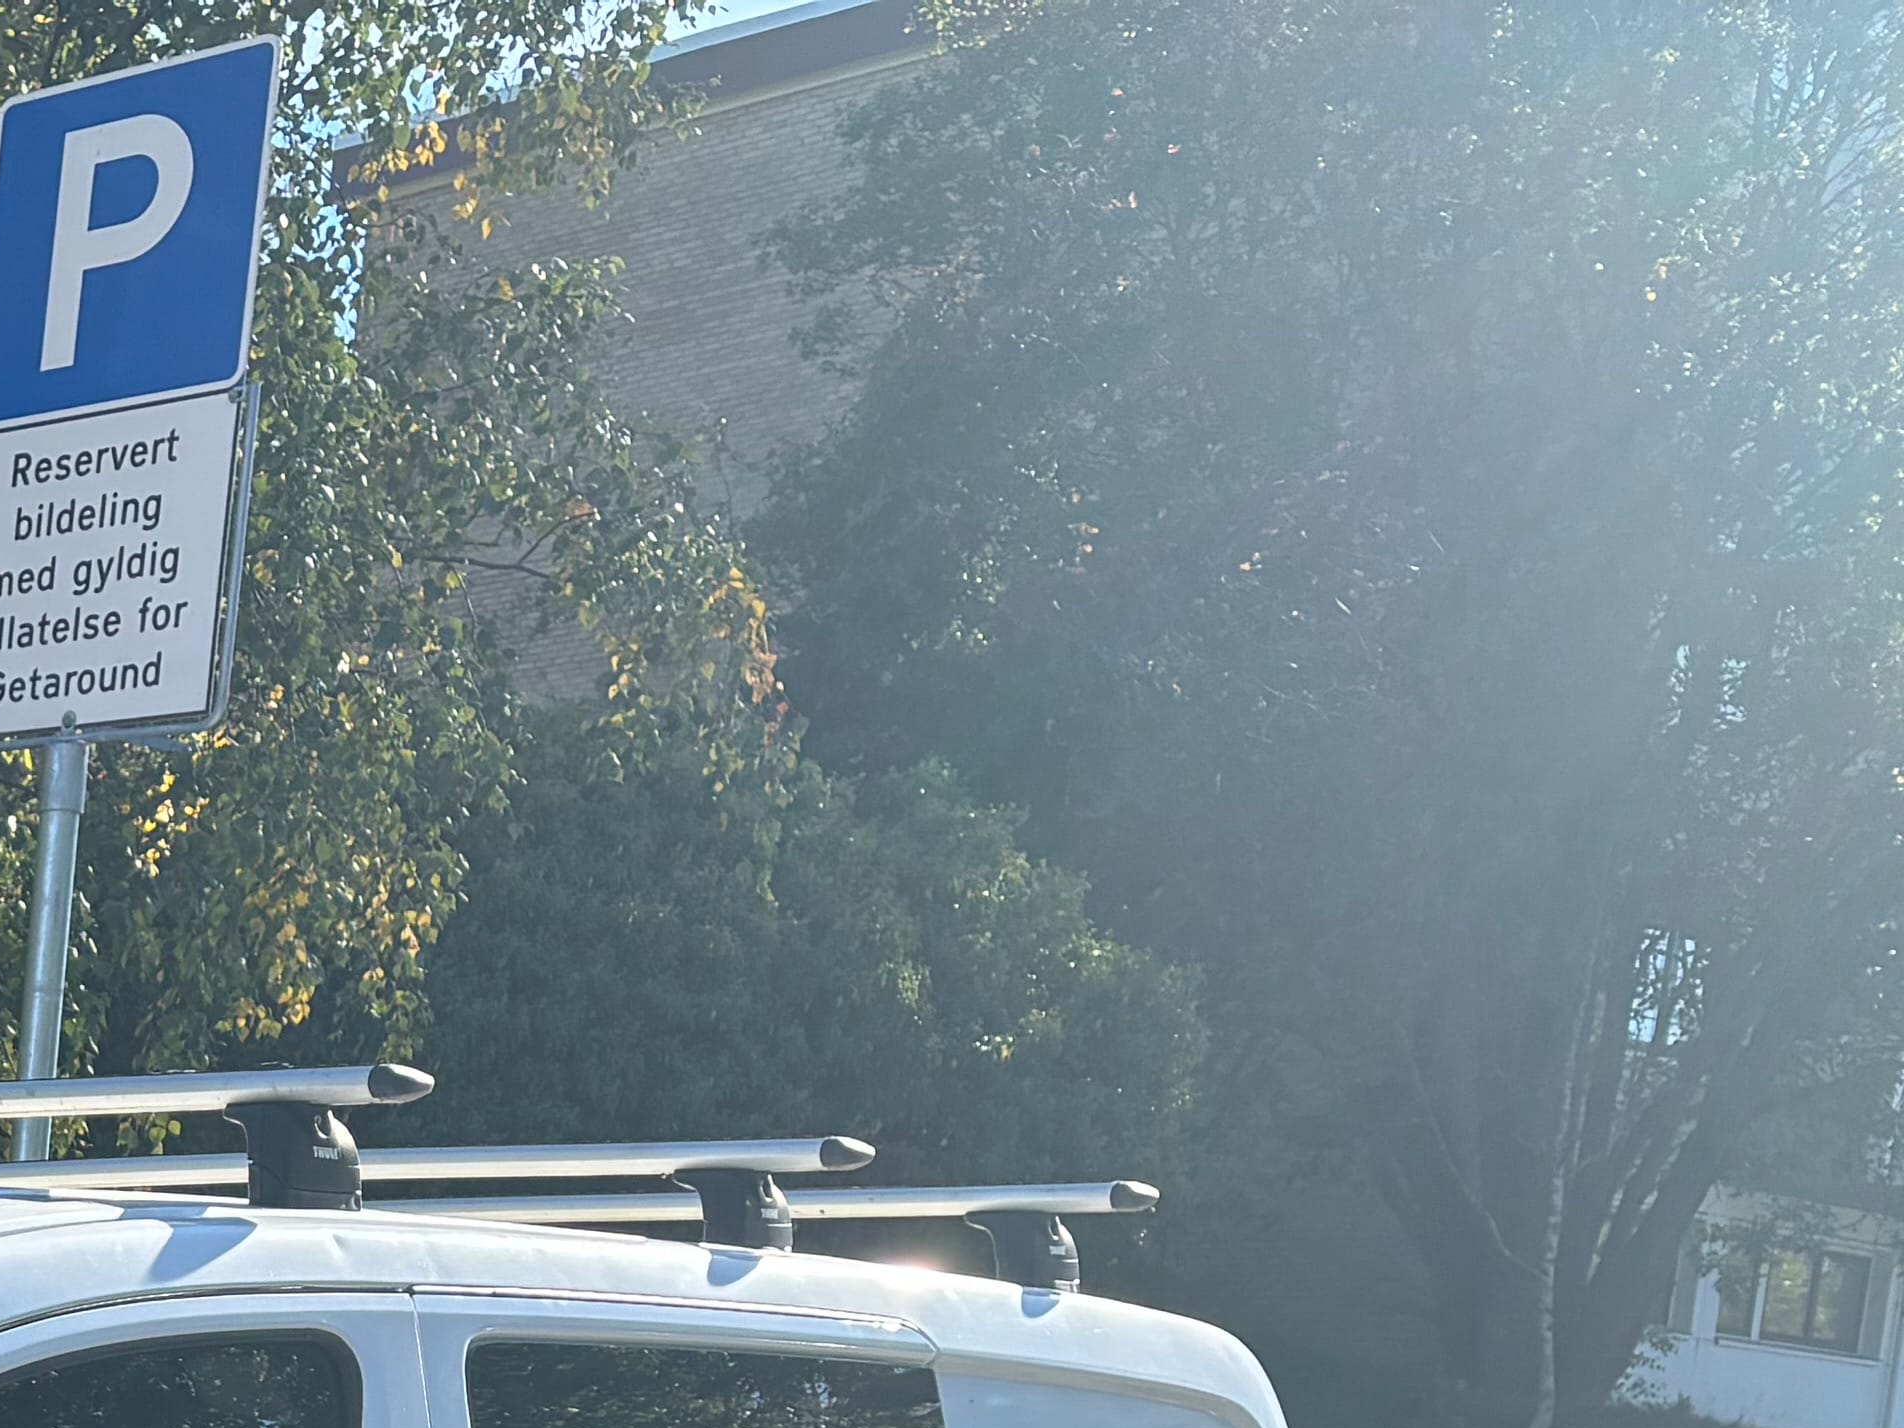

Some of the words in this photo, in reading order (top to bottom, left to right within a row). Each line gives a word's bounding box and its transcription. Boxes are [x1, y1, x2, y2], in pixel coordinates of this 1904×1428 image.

[39, 113, 195, 372] P
[11, 428, 180, 488] Reservert
[14, 492, 163, 542] bildeling
[72, 541, 181, 596] gyldig
[137, 596, 189, 636] for
